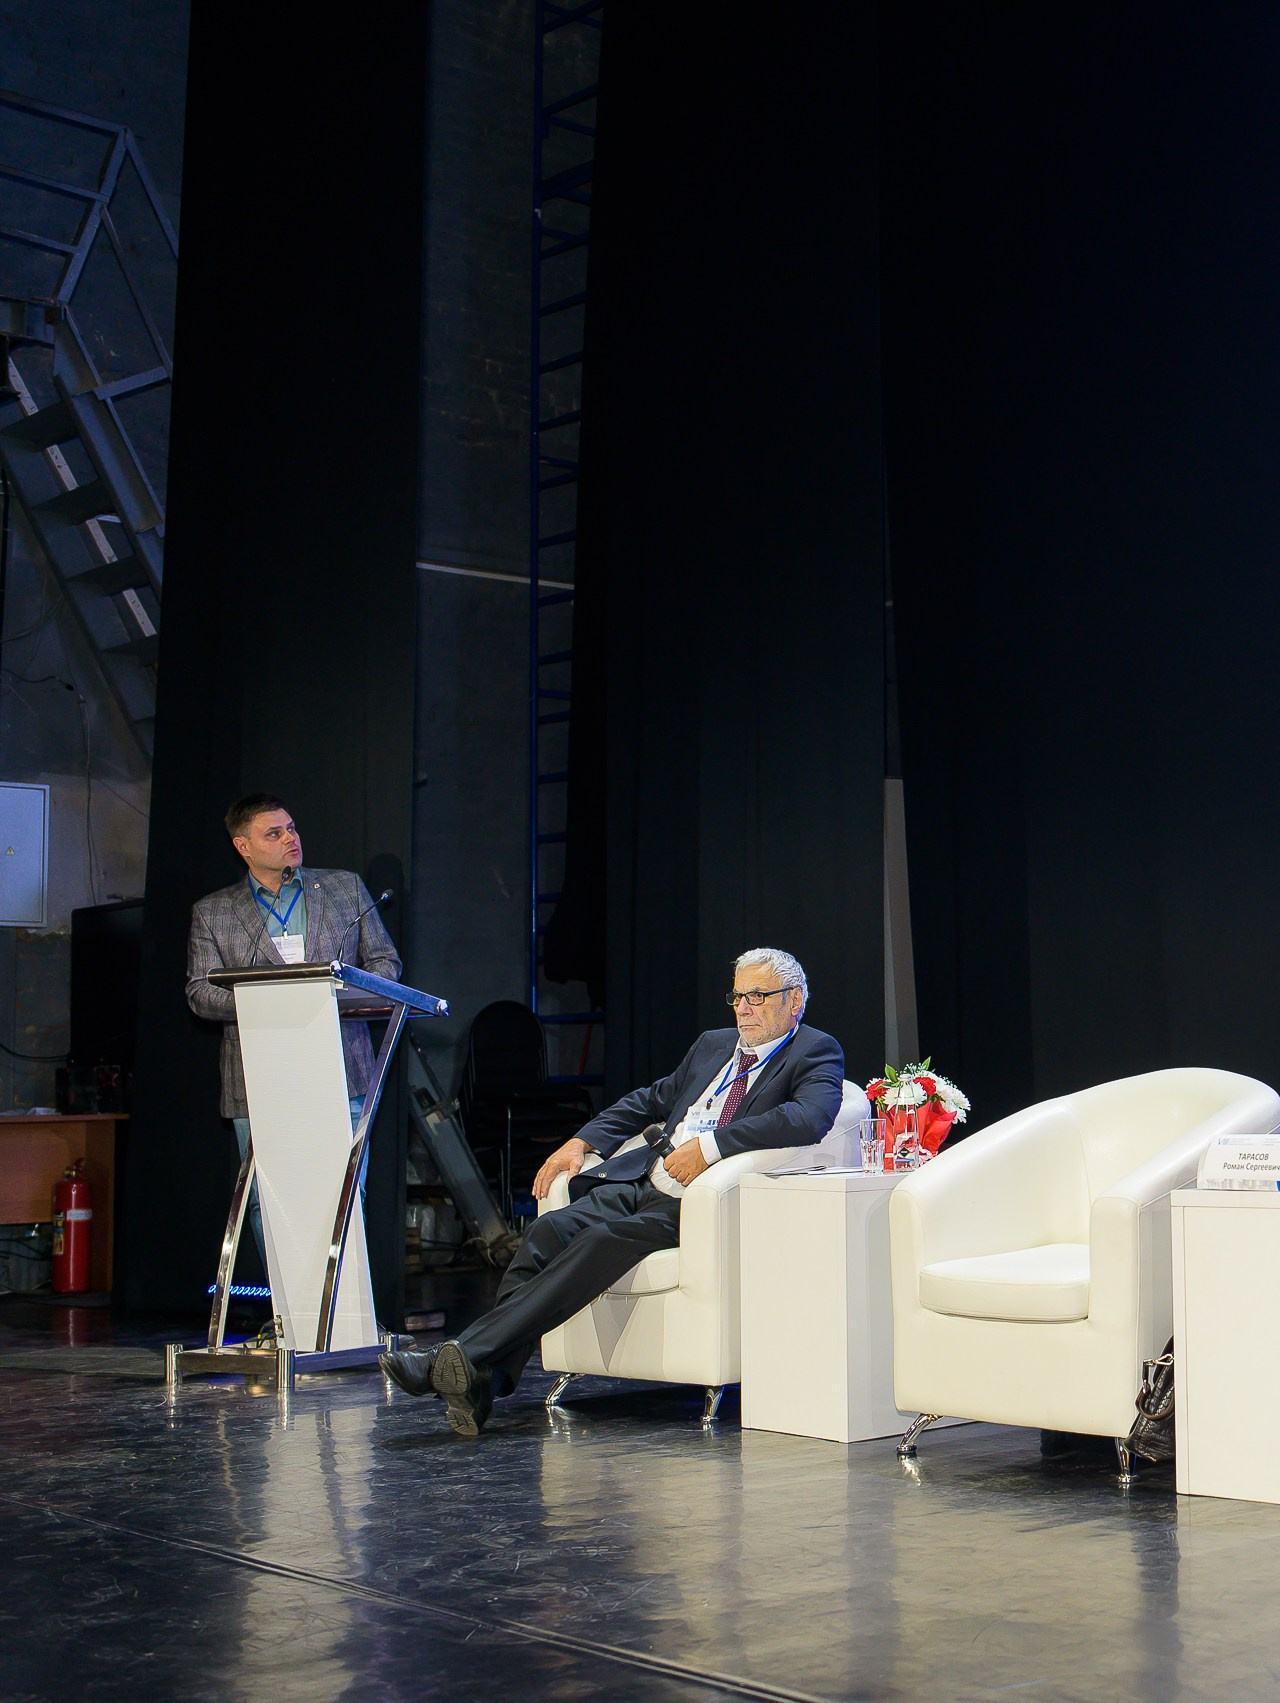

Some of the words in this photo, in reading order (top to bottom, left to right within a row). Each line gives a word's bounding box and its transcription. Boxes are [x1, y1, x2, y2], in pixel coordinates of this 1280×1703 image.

[1238, 1152, 1269, 1161] ТАРАСОВ
[1222, 1162, 1245, 1170] Роман
[1245, 1162, 1280, 1173] Сергеевич
